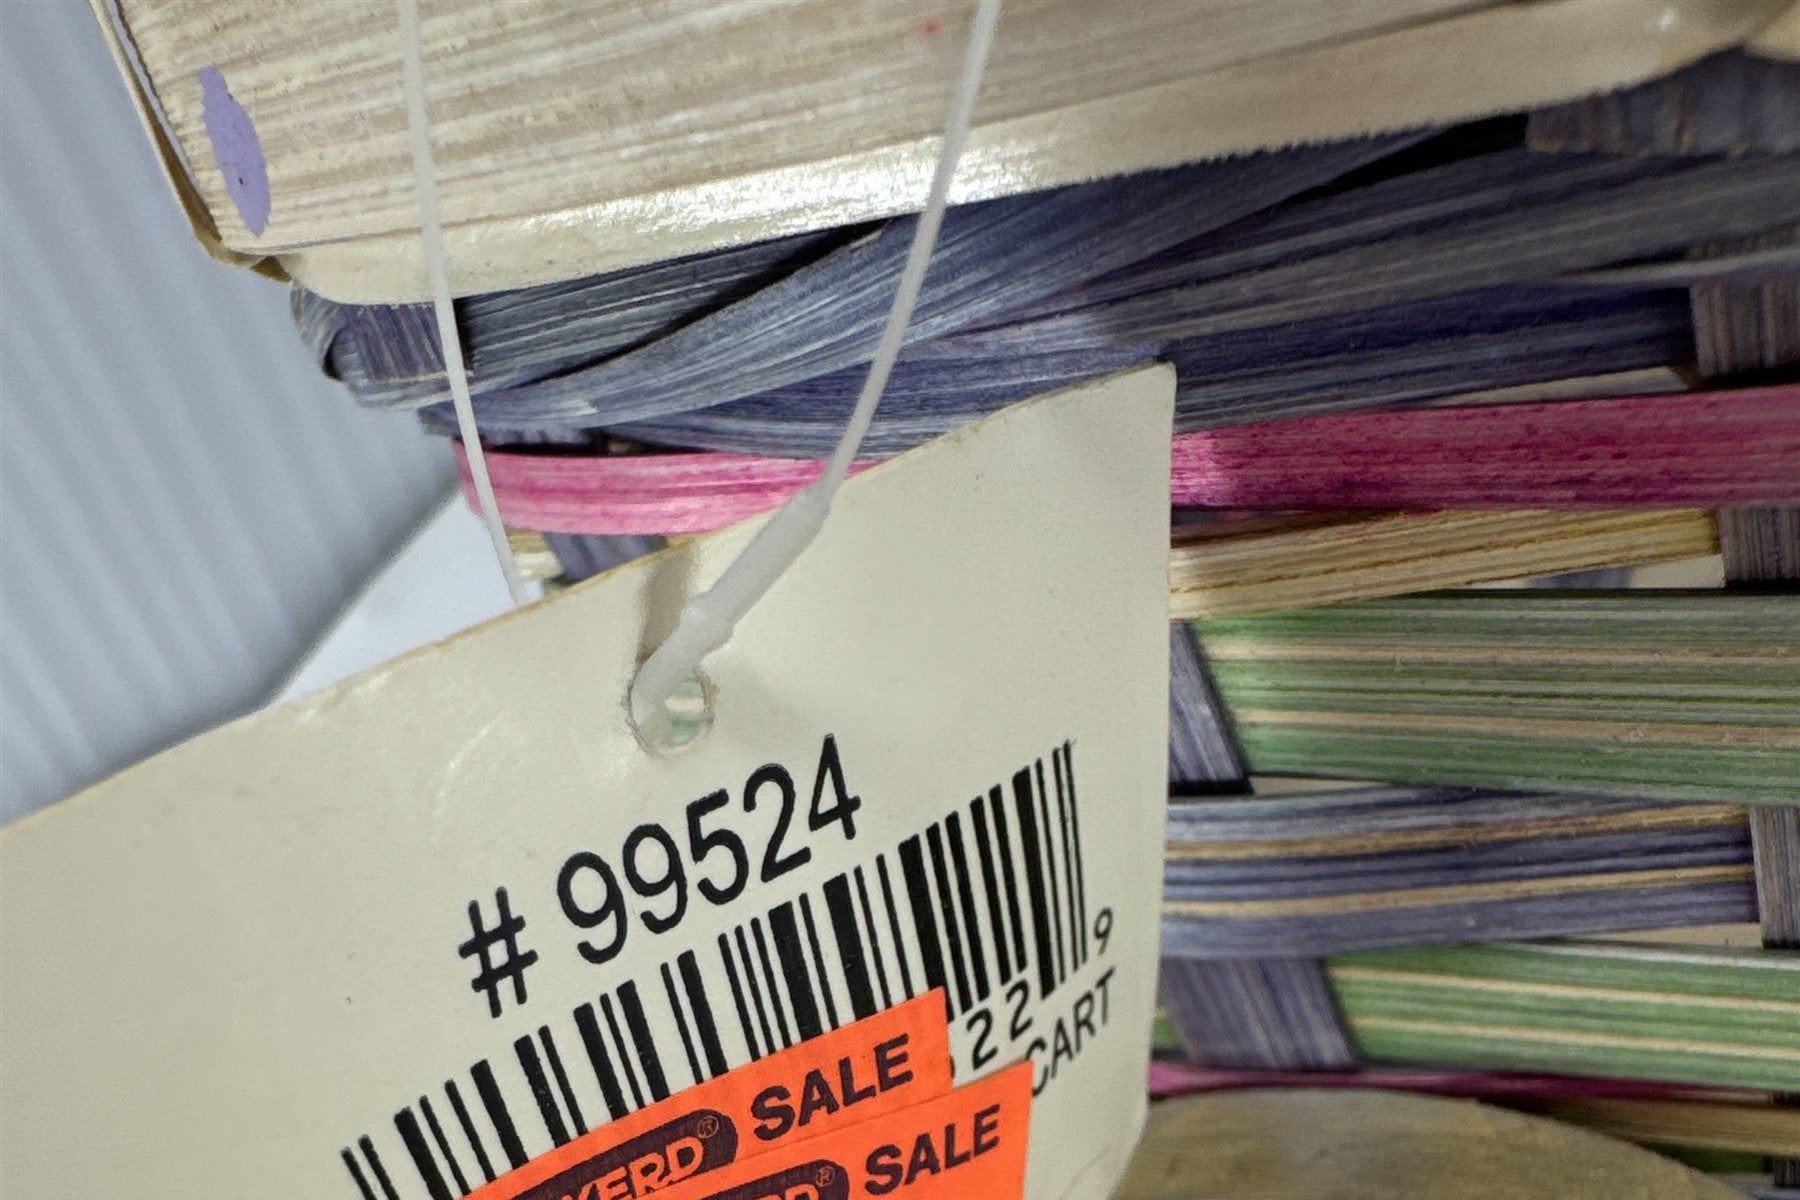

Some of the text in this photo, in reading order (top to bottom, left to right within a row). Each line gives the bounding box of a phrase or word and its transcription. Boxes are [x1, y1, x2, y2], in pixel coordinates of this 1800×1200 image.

[458, 733, 861, 1018] # 99524
[1093, 906, 1114, 956] 9
[1025, 965, 1116, 1098] CART
[751, 1033, 915, 1141] SALE
[864, 1103, 1001, 1196] SALE
